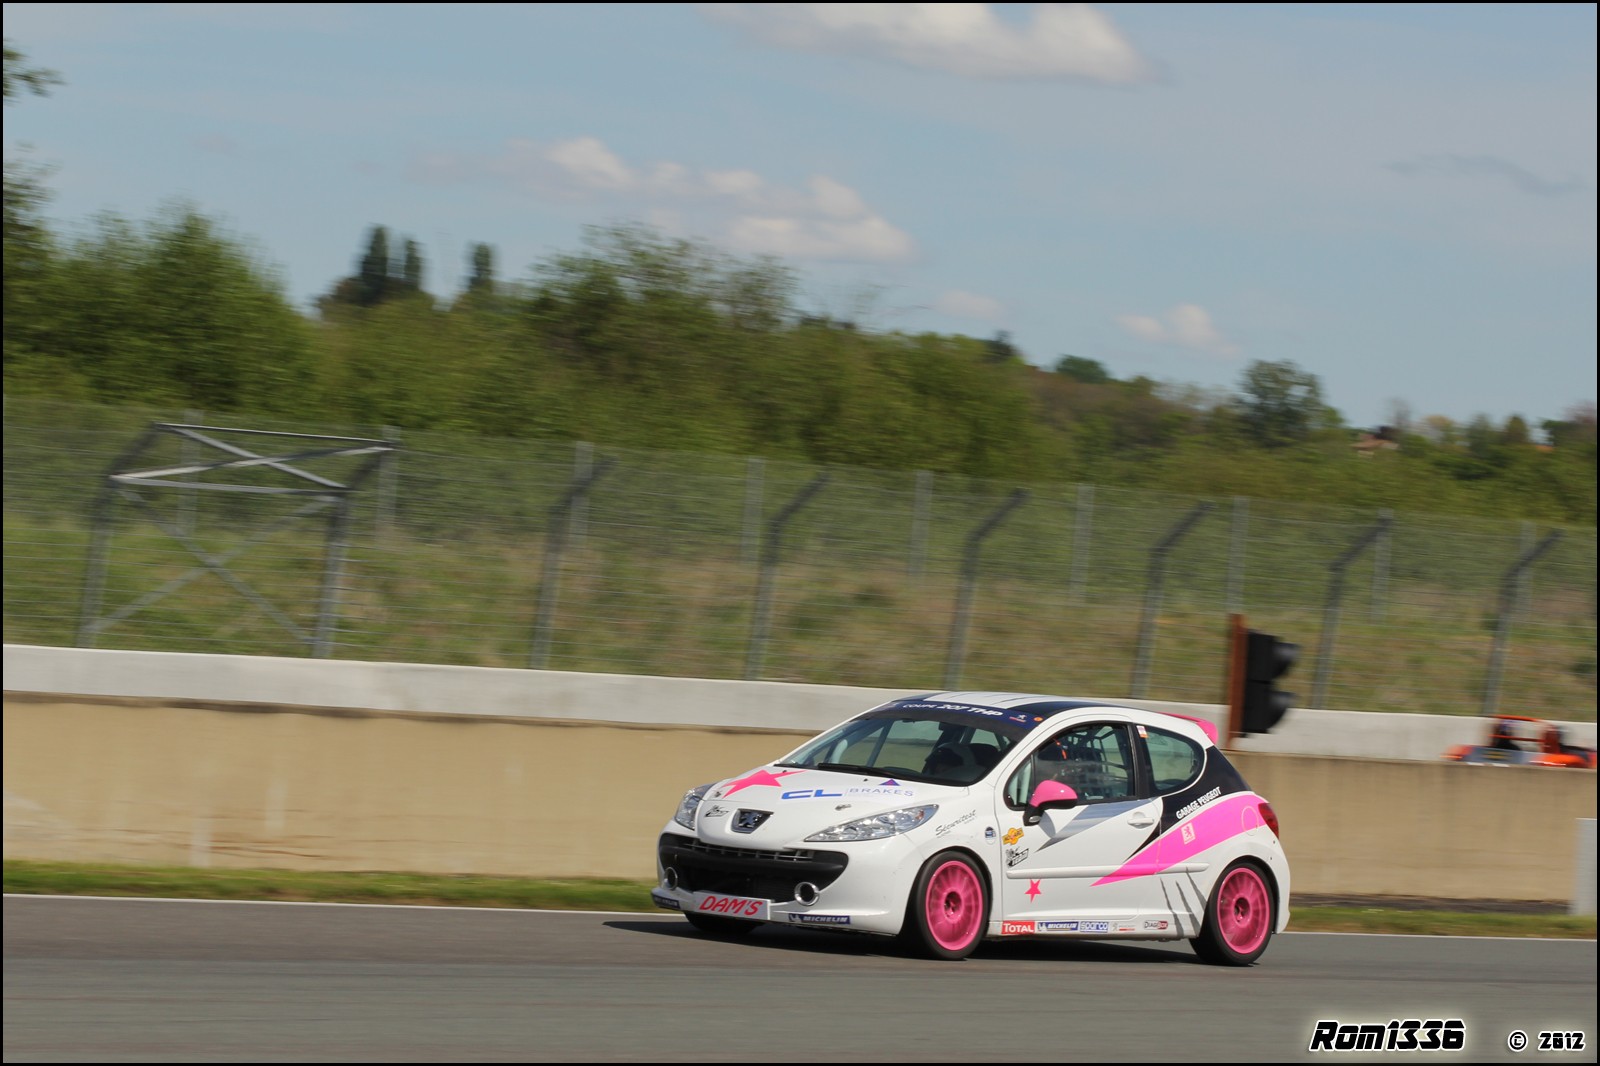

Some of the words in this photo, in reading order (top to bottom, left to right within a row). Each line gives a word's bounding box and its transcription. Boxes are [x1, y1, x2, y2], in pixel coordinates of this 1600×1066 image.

[781, 789, 842, 800] CL
[849, 787, 913, 797] BRAKES
[1176, 801, 1200, 819] GARAGE
[1197, 786, 1222, 806] PEUGEOT
[699, 896, 763, 916] DAM'S
[1080, 921, 1108, 931] sparco
